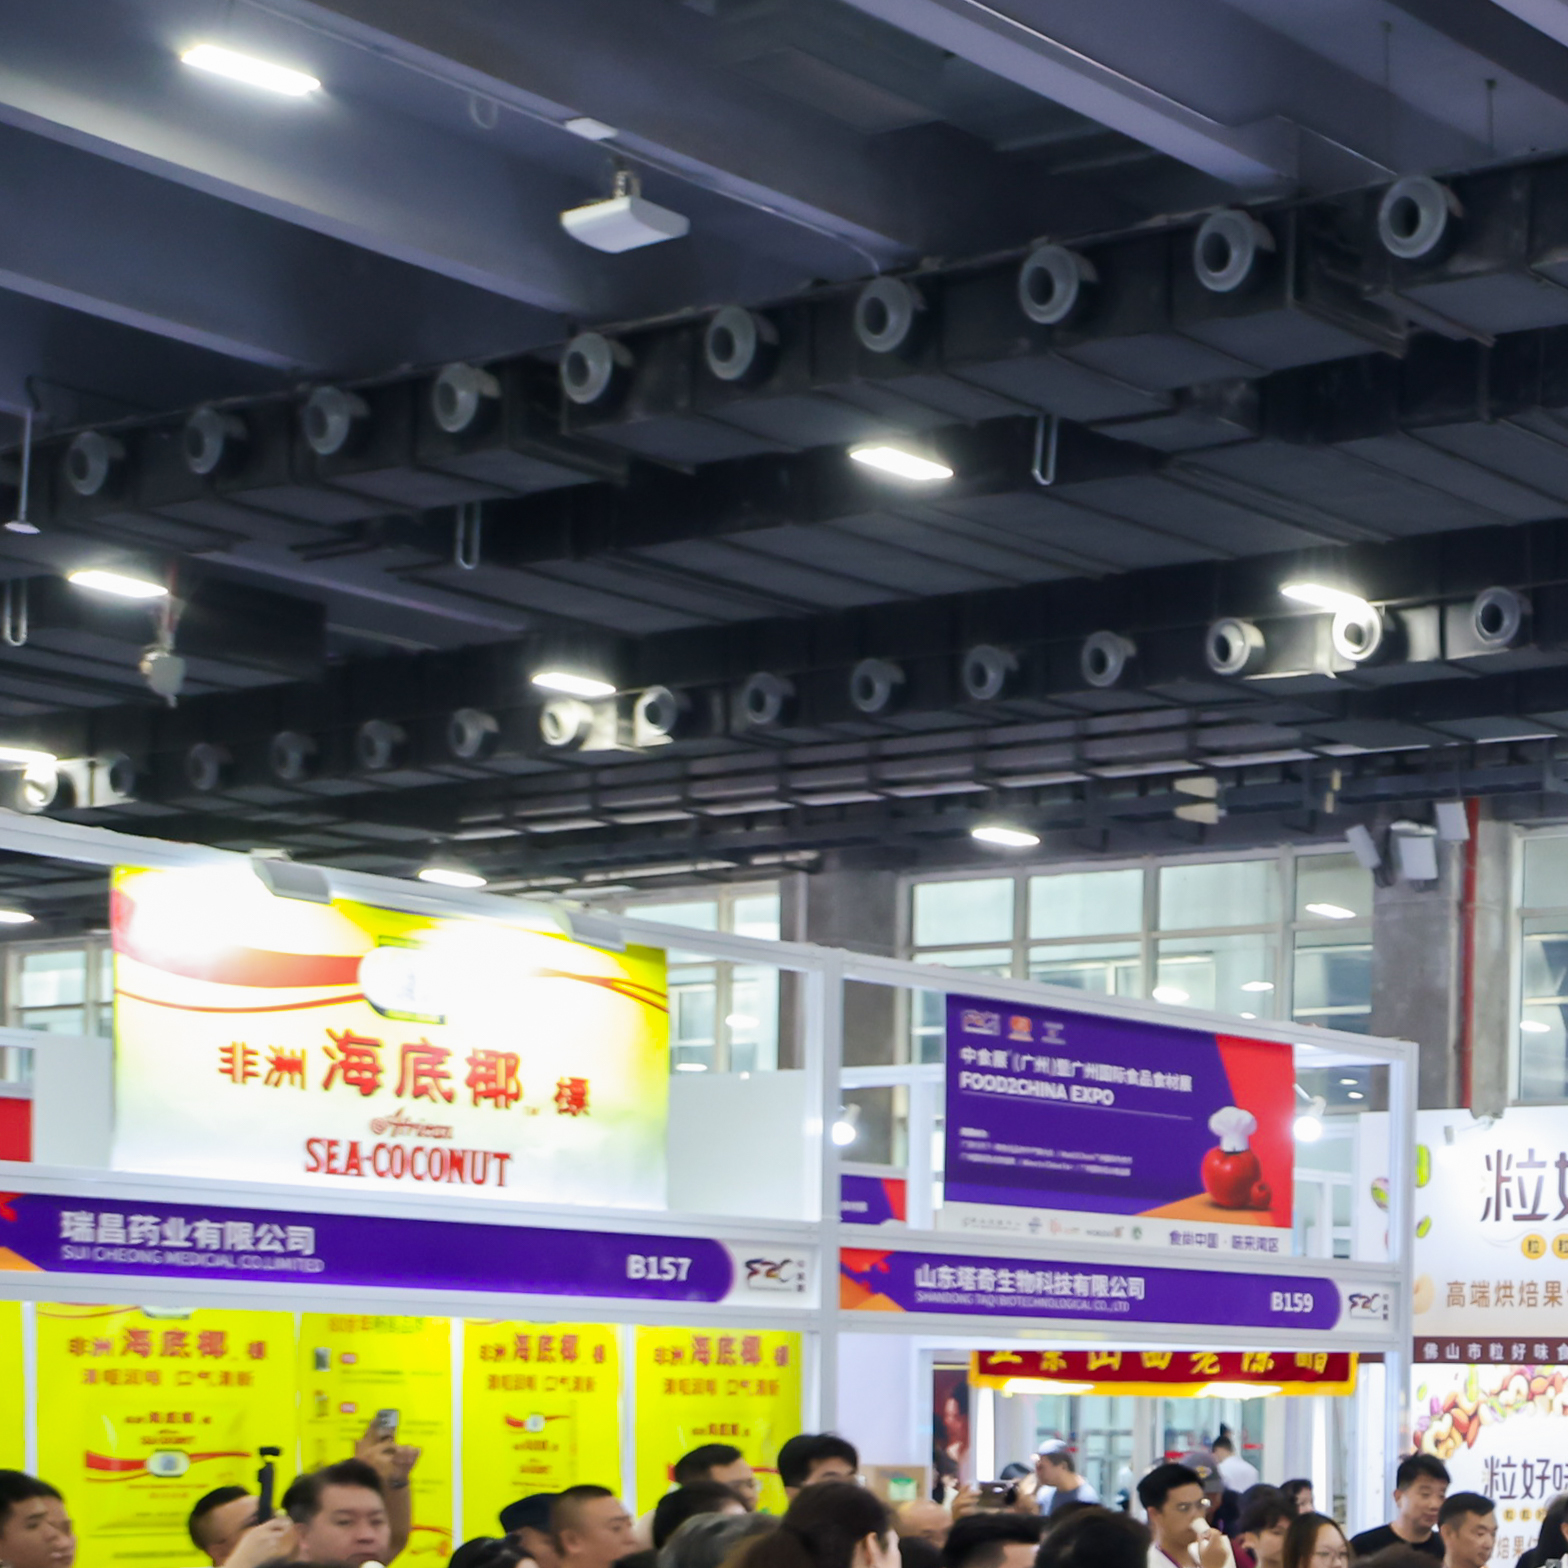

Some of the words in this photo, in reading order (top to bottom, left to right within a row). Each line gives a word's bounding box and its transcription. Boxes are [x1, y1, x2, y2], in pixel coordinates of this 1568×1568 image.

[959, 1071, 1068, 1101] FOOD2CHINA
[1070, 1085, 1115, 1106] EXPO
[304, 1138, 514, 1187] SEA-COCONUT
[59, 1210, 316, 1256] 瑞昌药业有限公司
[627, 1254, 692, 1281] B157
[914, 1263, 1145, 1300] 山东塔奇生物科技有限公司
[1270, 1291, 1314, 1313] B159
